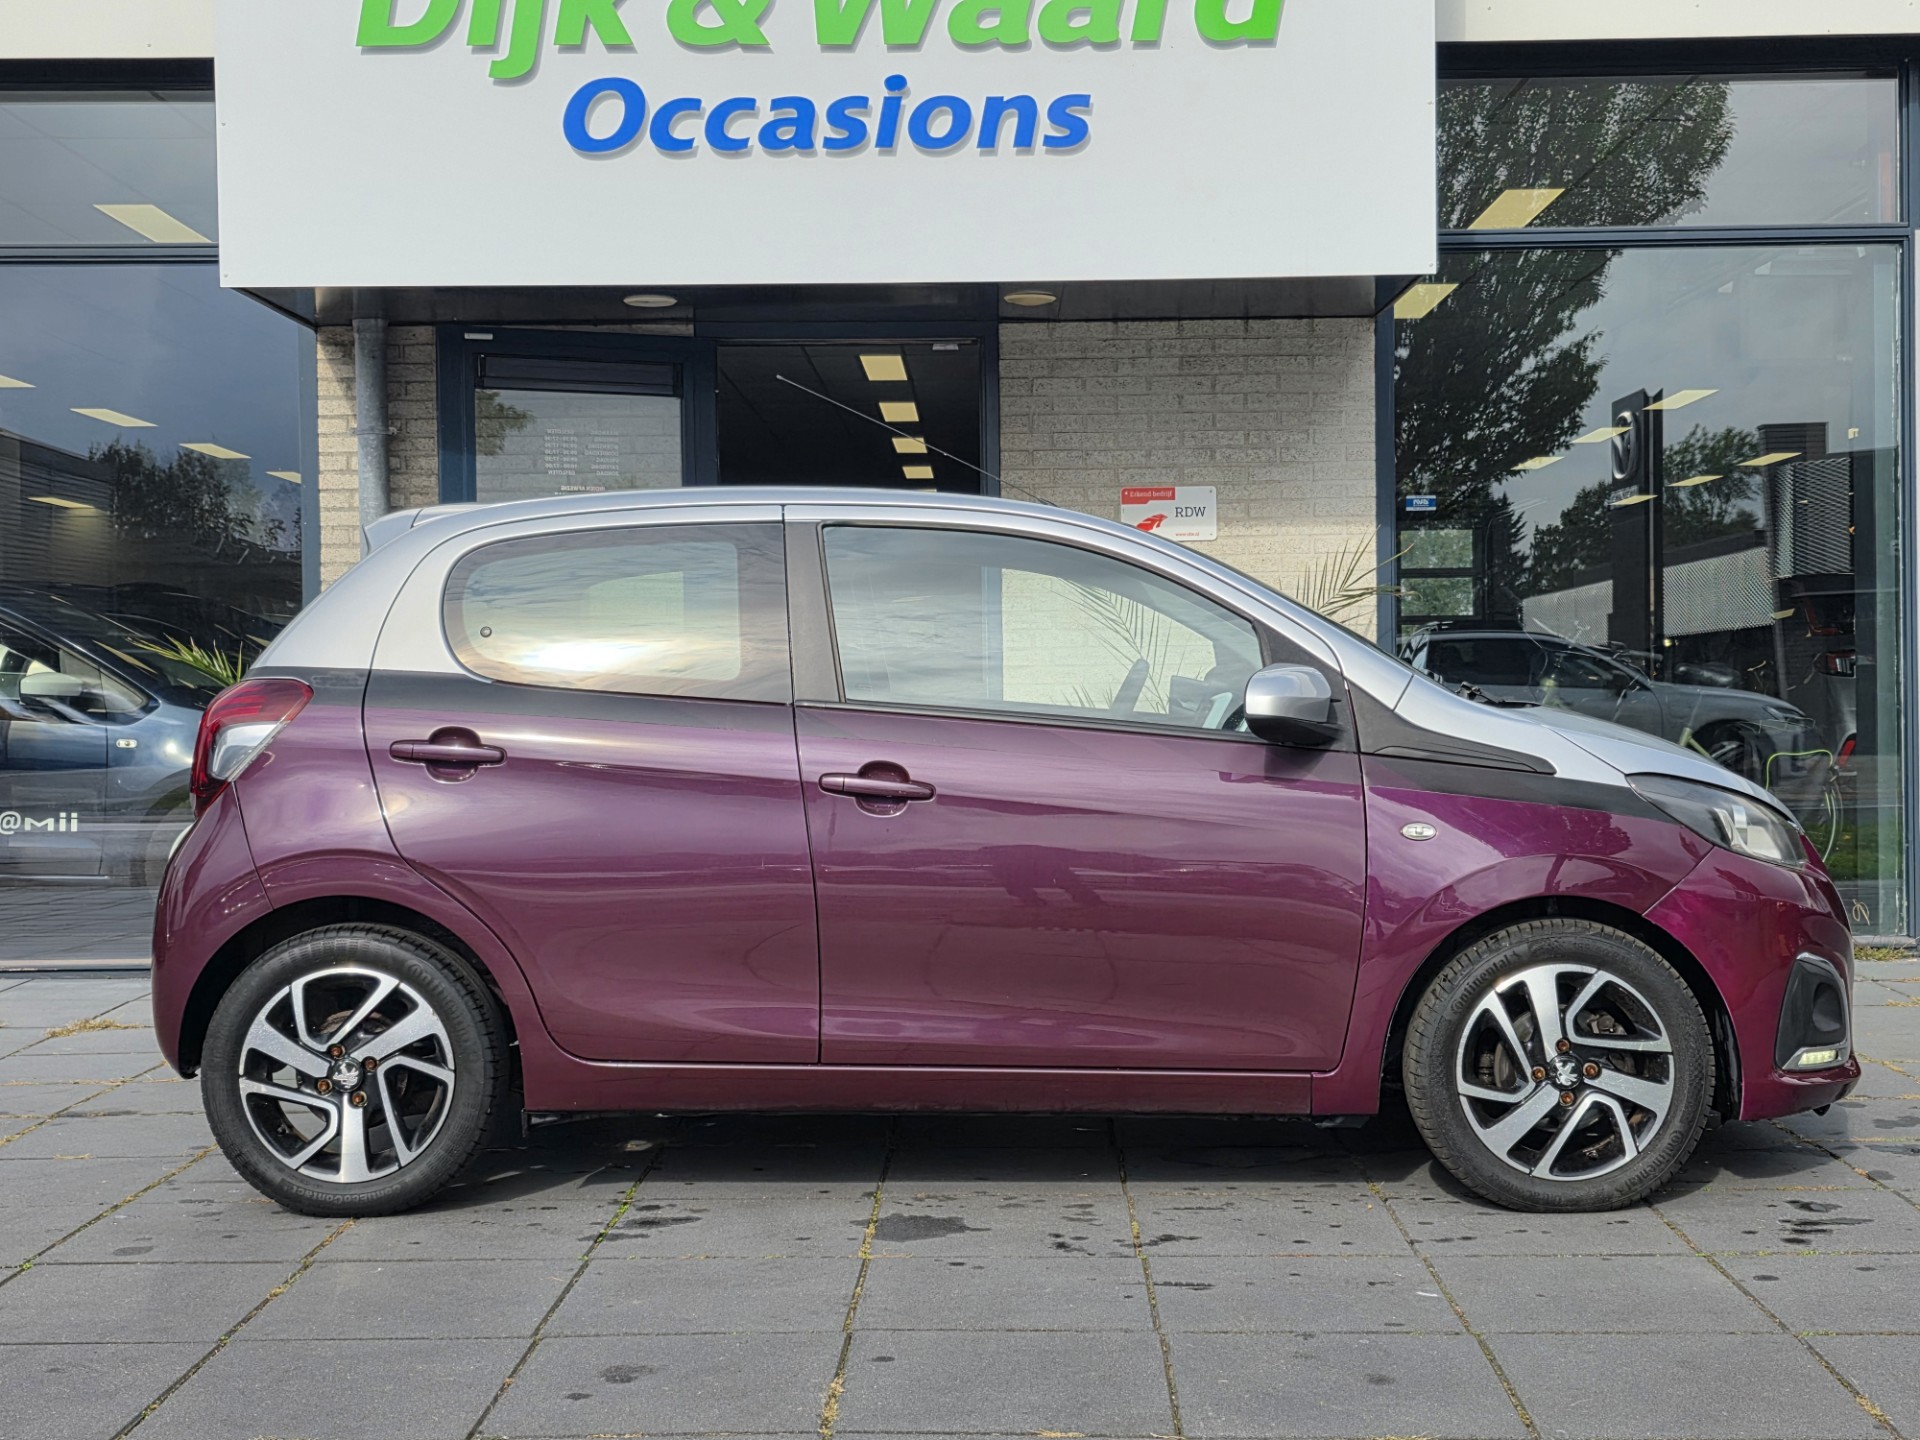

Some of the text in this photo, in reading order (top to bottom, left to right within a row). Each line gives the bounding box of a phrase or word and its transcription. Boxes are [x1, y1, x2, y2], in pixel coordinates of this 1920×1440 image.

[563, 73, 1092, 153] Occasions
[1153, 489, 1173, 498] bedrijf
[1175, 506, 1206, 518] RDW
